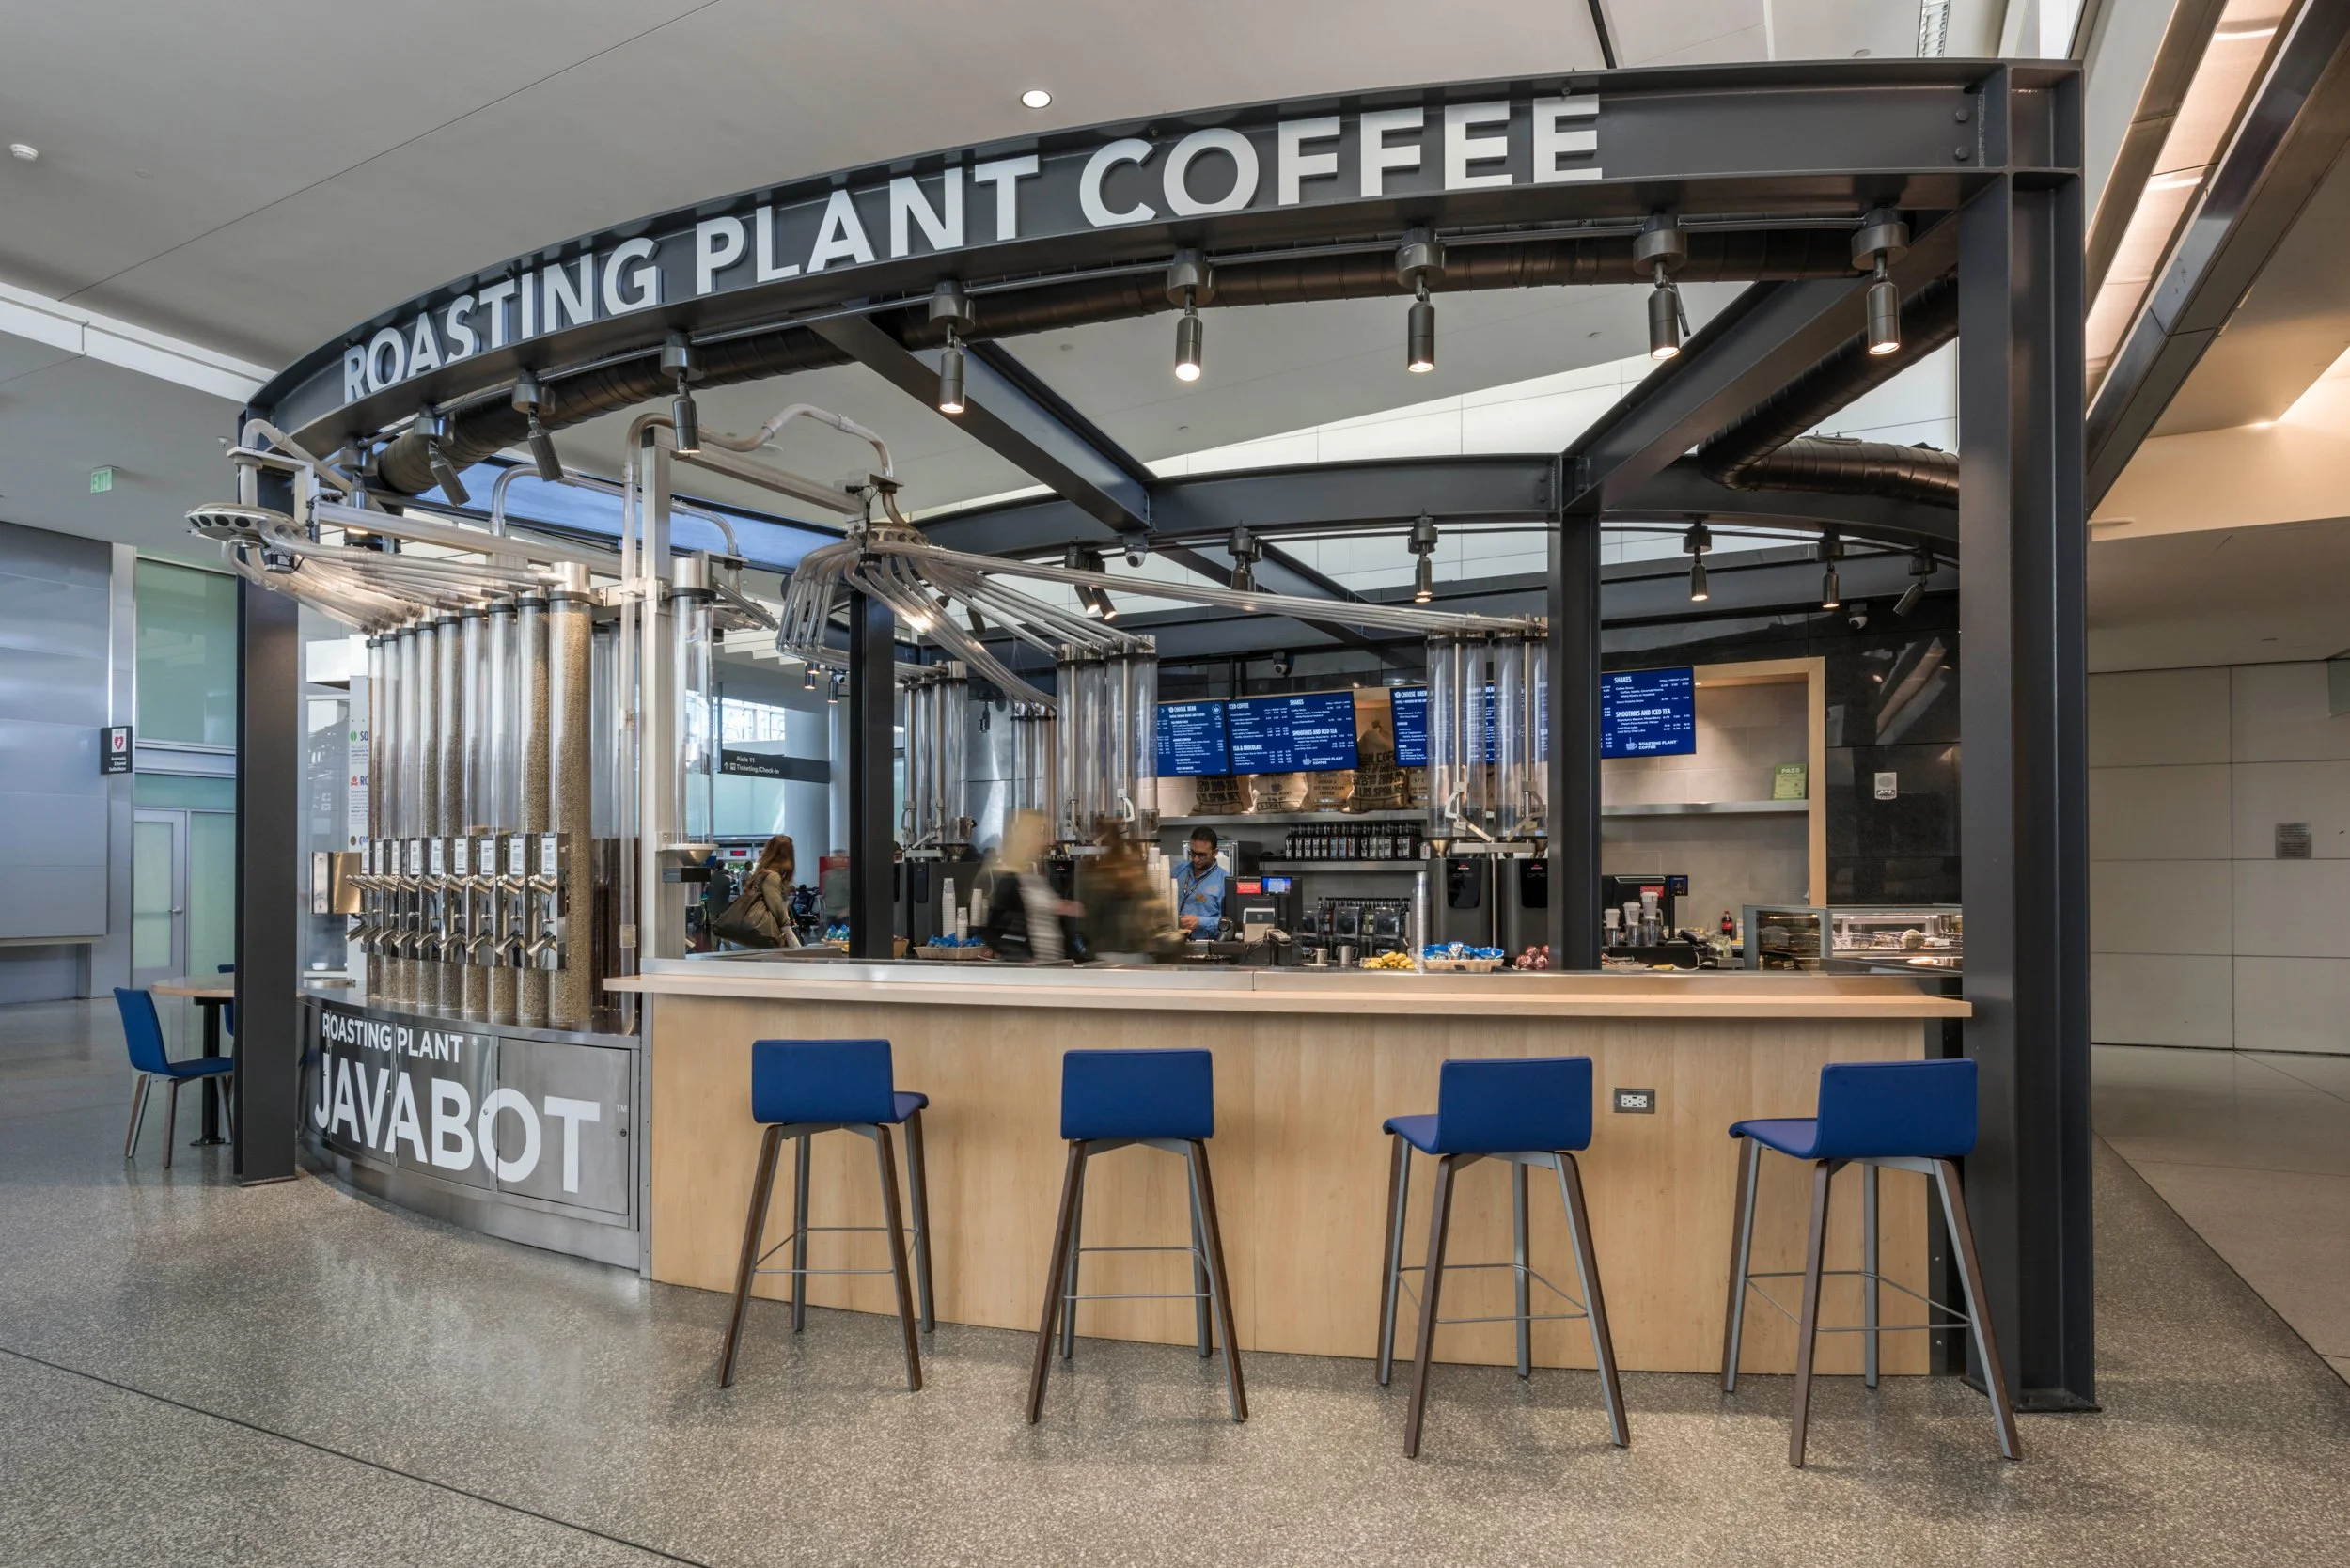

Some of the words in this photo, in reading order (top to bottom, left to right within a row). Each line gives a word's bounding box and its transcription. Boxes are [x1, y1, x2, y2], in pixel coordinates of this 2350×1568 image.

[343, 237, 663, 404] ROASTING
[696, 154, 1040, 295] PLANT
[1079, 94, 1603, 227] COFFEE
[92, 472, 109, 492] EXIT
[736, 763, 780, 774] Ticketing/Check-in
[322, 1013, 392, 1051] ROASTING
[397, 1027, 463, 1063] PLANT
[314, 1053, 601, 1193] JAVABOT
